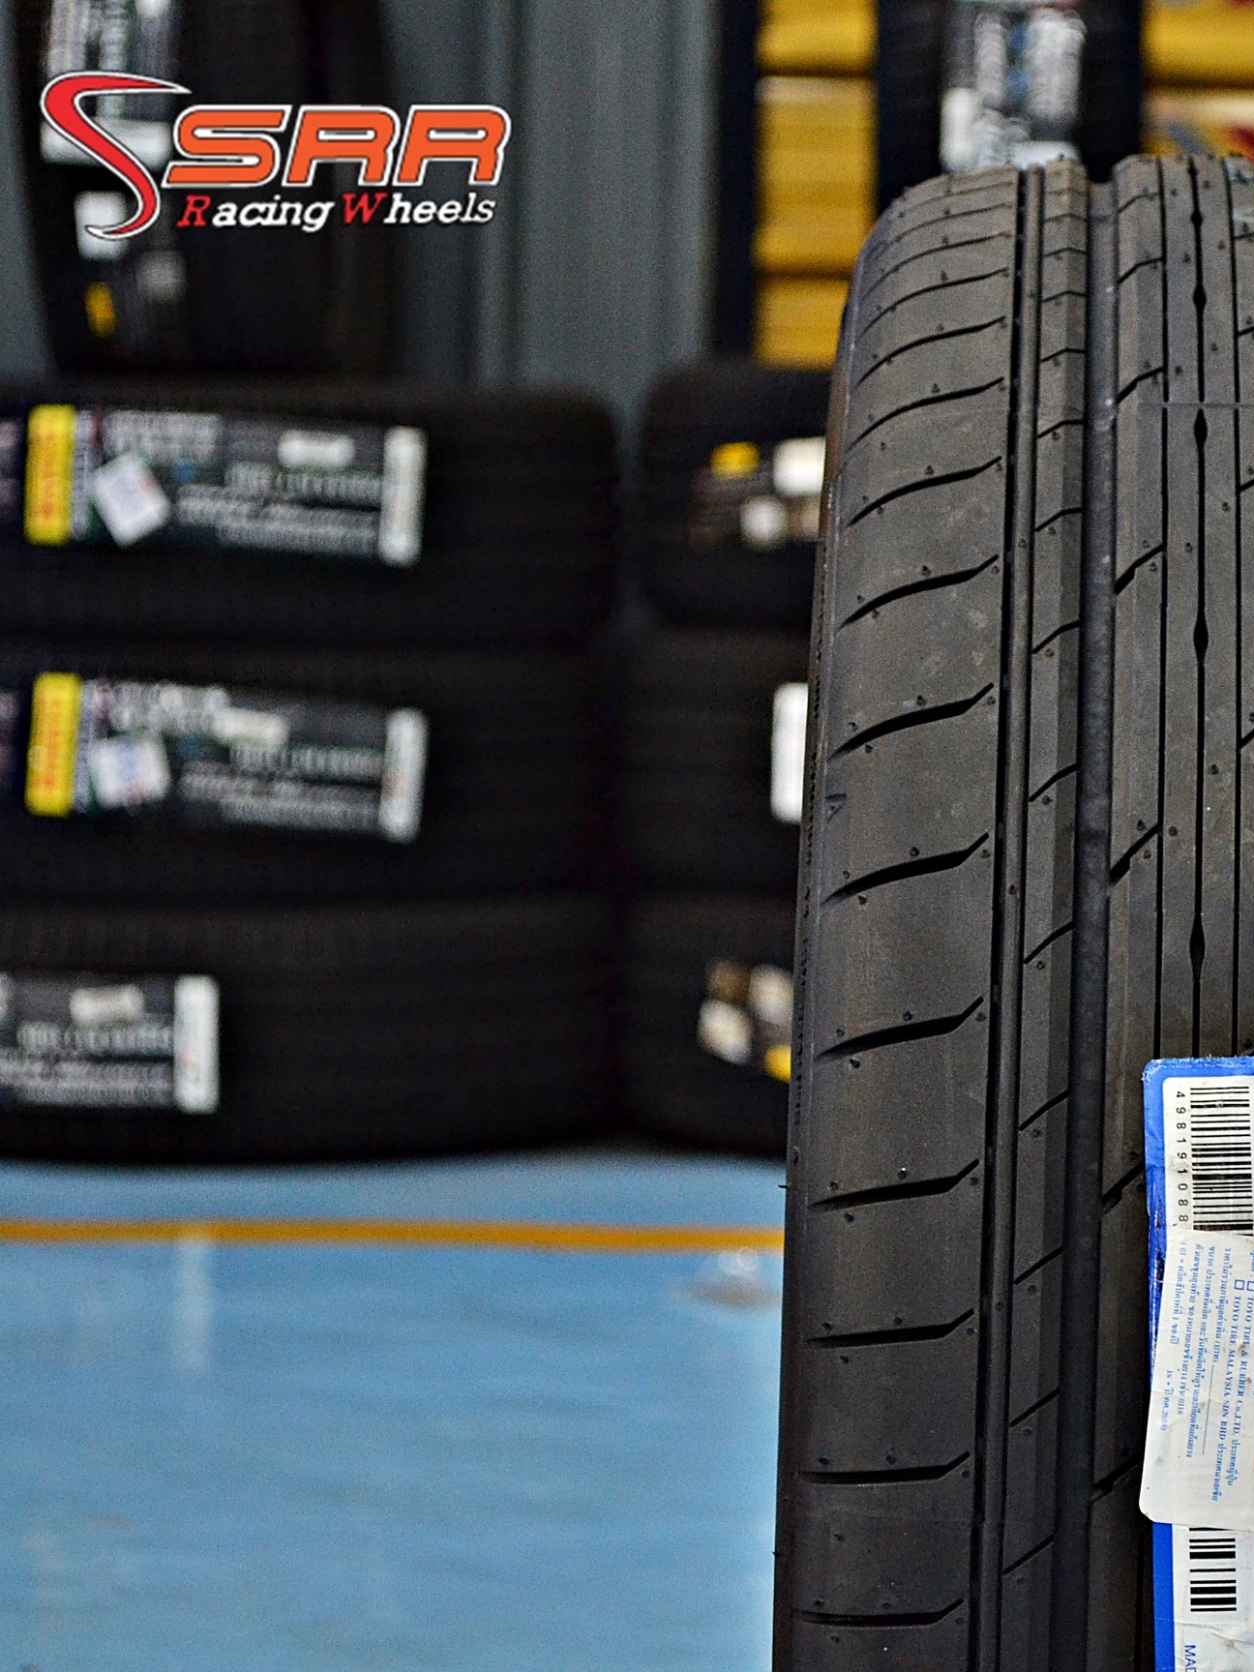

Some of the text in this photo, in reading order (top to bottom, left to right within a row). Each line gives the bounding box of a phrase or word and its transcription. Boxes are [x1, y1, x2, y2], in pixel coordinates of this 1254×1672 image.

[1231, 1295, 1241, 1321] TOYO
[1244, 1296, 1254, 1322] TOYO
[1228, 1324, 1238, 1346] TIRE
[1242, 1325, 1251, 1346] TIRE
[1223, 1349, 1235, 1396] MALAYSIA
[1236, 1360, 1247, 1396] RUBBER
[1221, 1399, 1230, 1417] SDN
[1218, 1420, 1227, 1440] BHD
